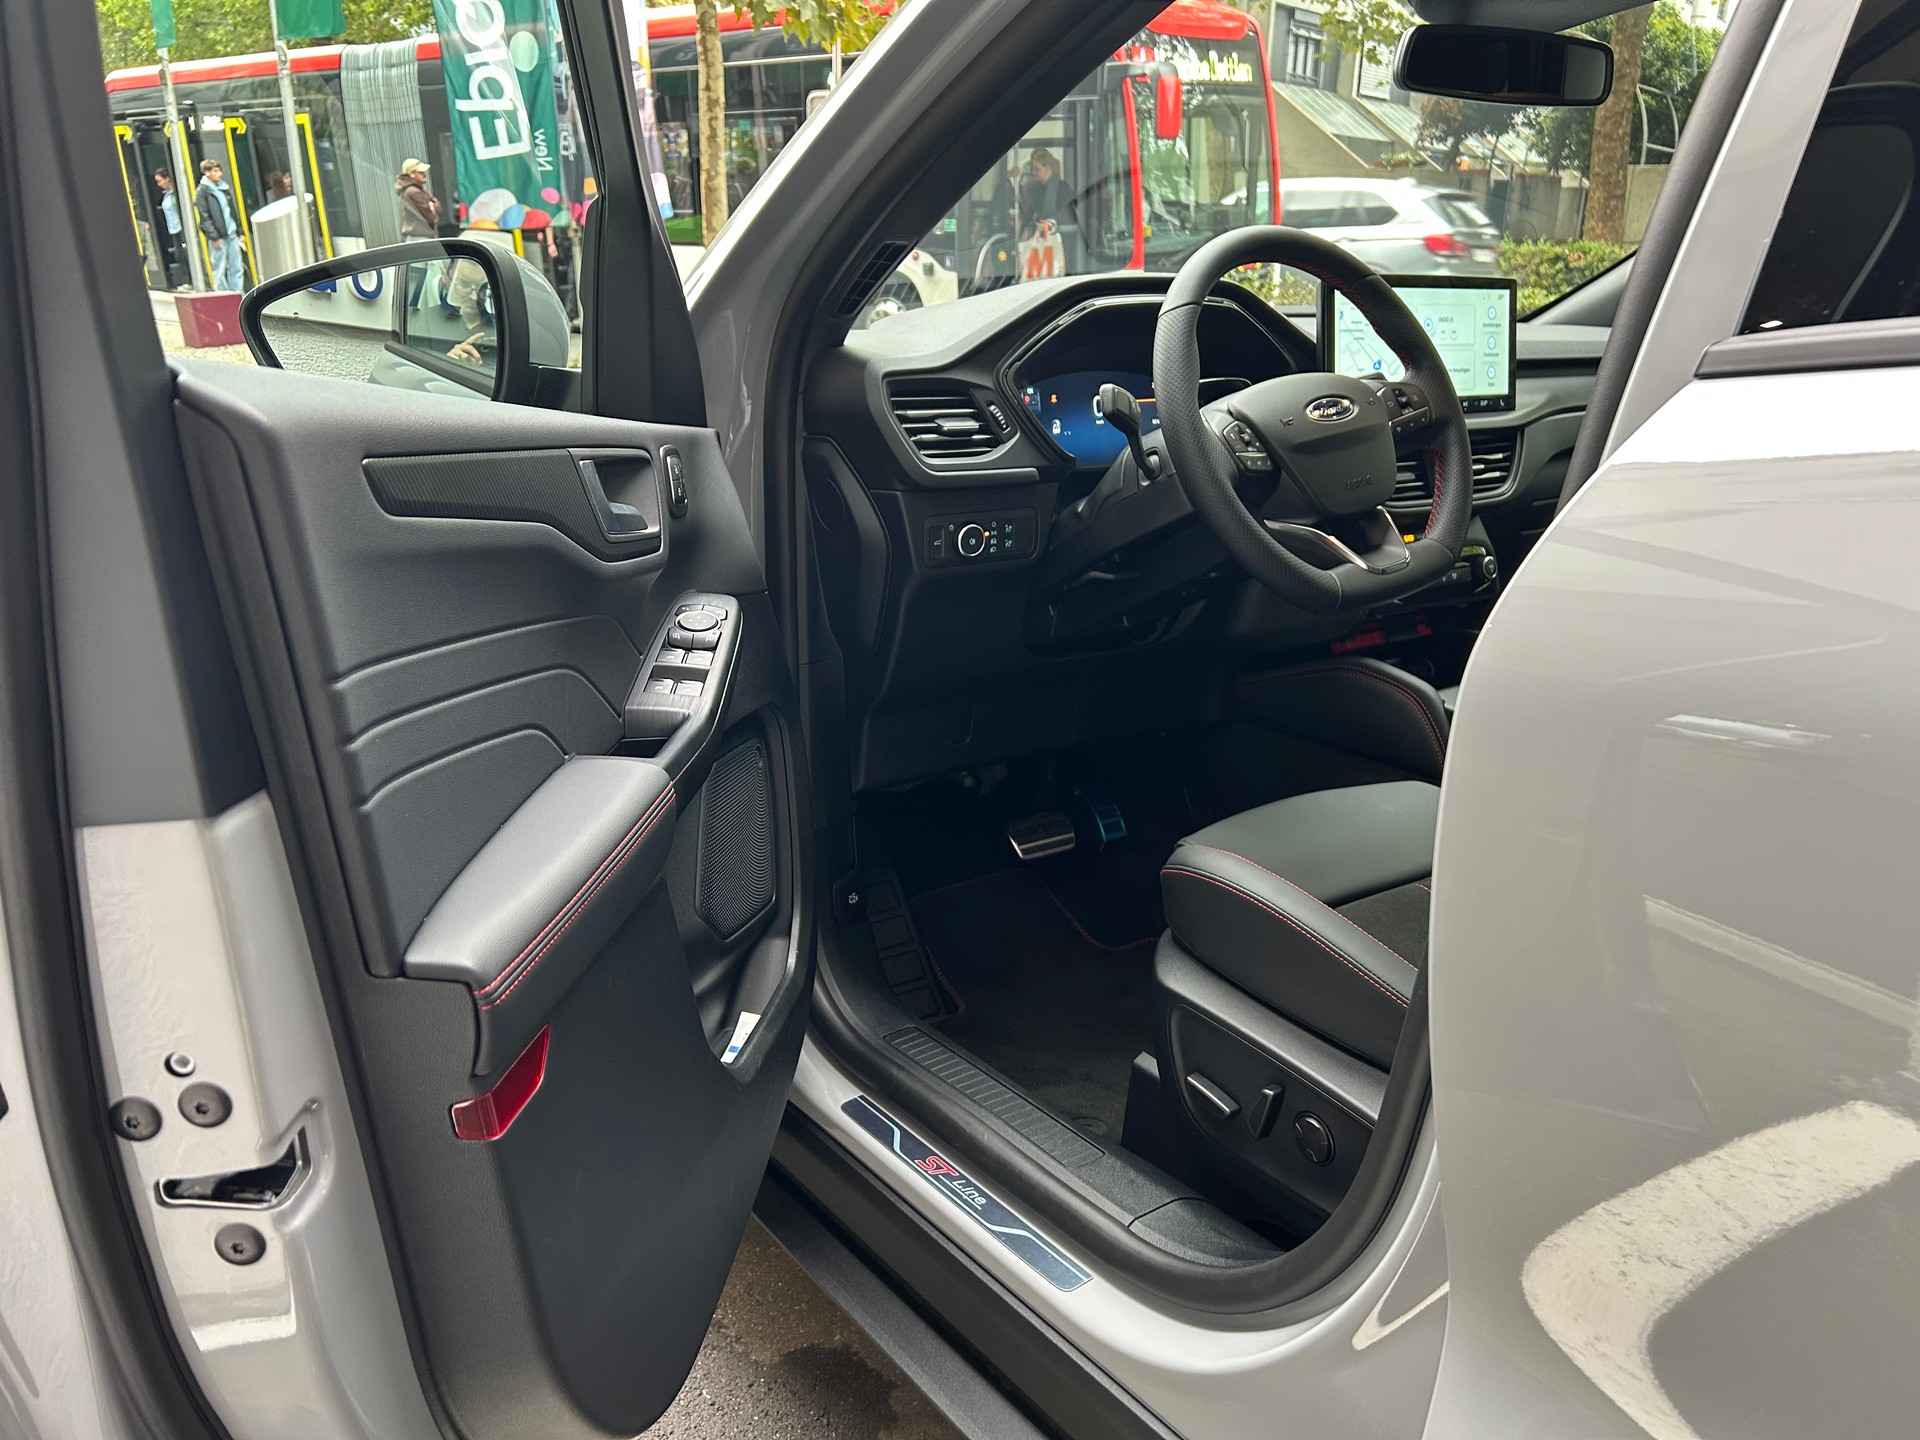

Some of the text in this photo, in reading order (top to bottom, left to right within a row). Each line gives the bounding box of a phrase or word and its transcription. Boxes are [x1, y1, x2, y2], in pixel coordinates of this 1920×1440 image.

[1026, 245, 1054, 280] M
[914, 1155, 987, 1206] ST Line
